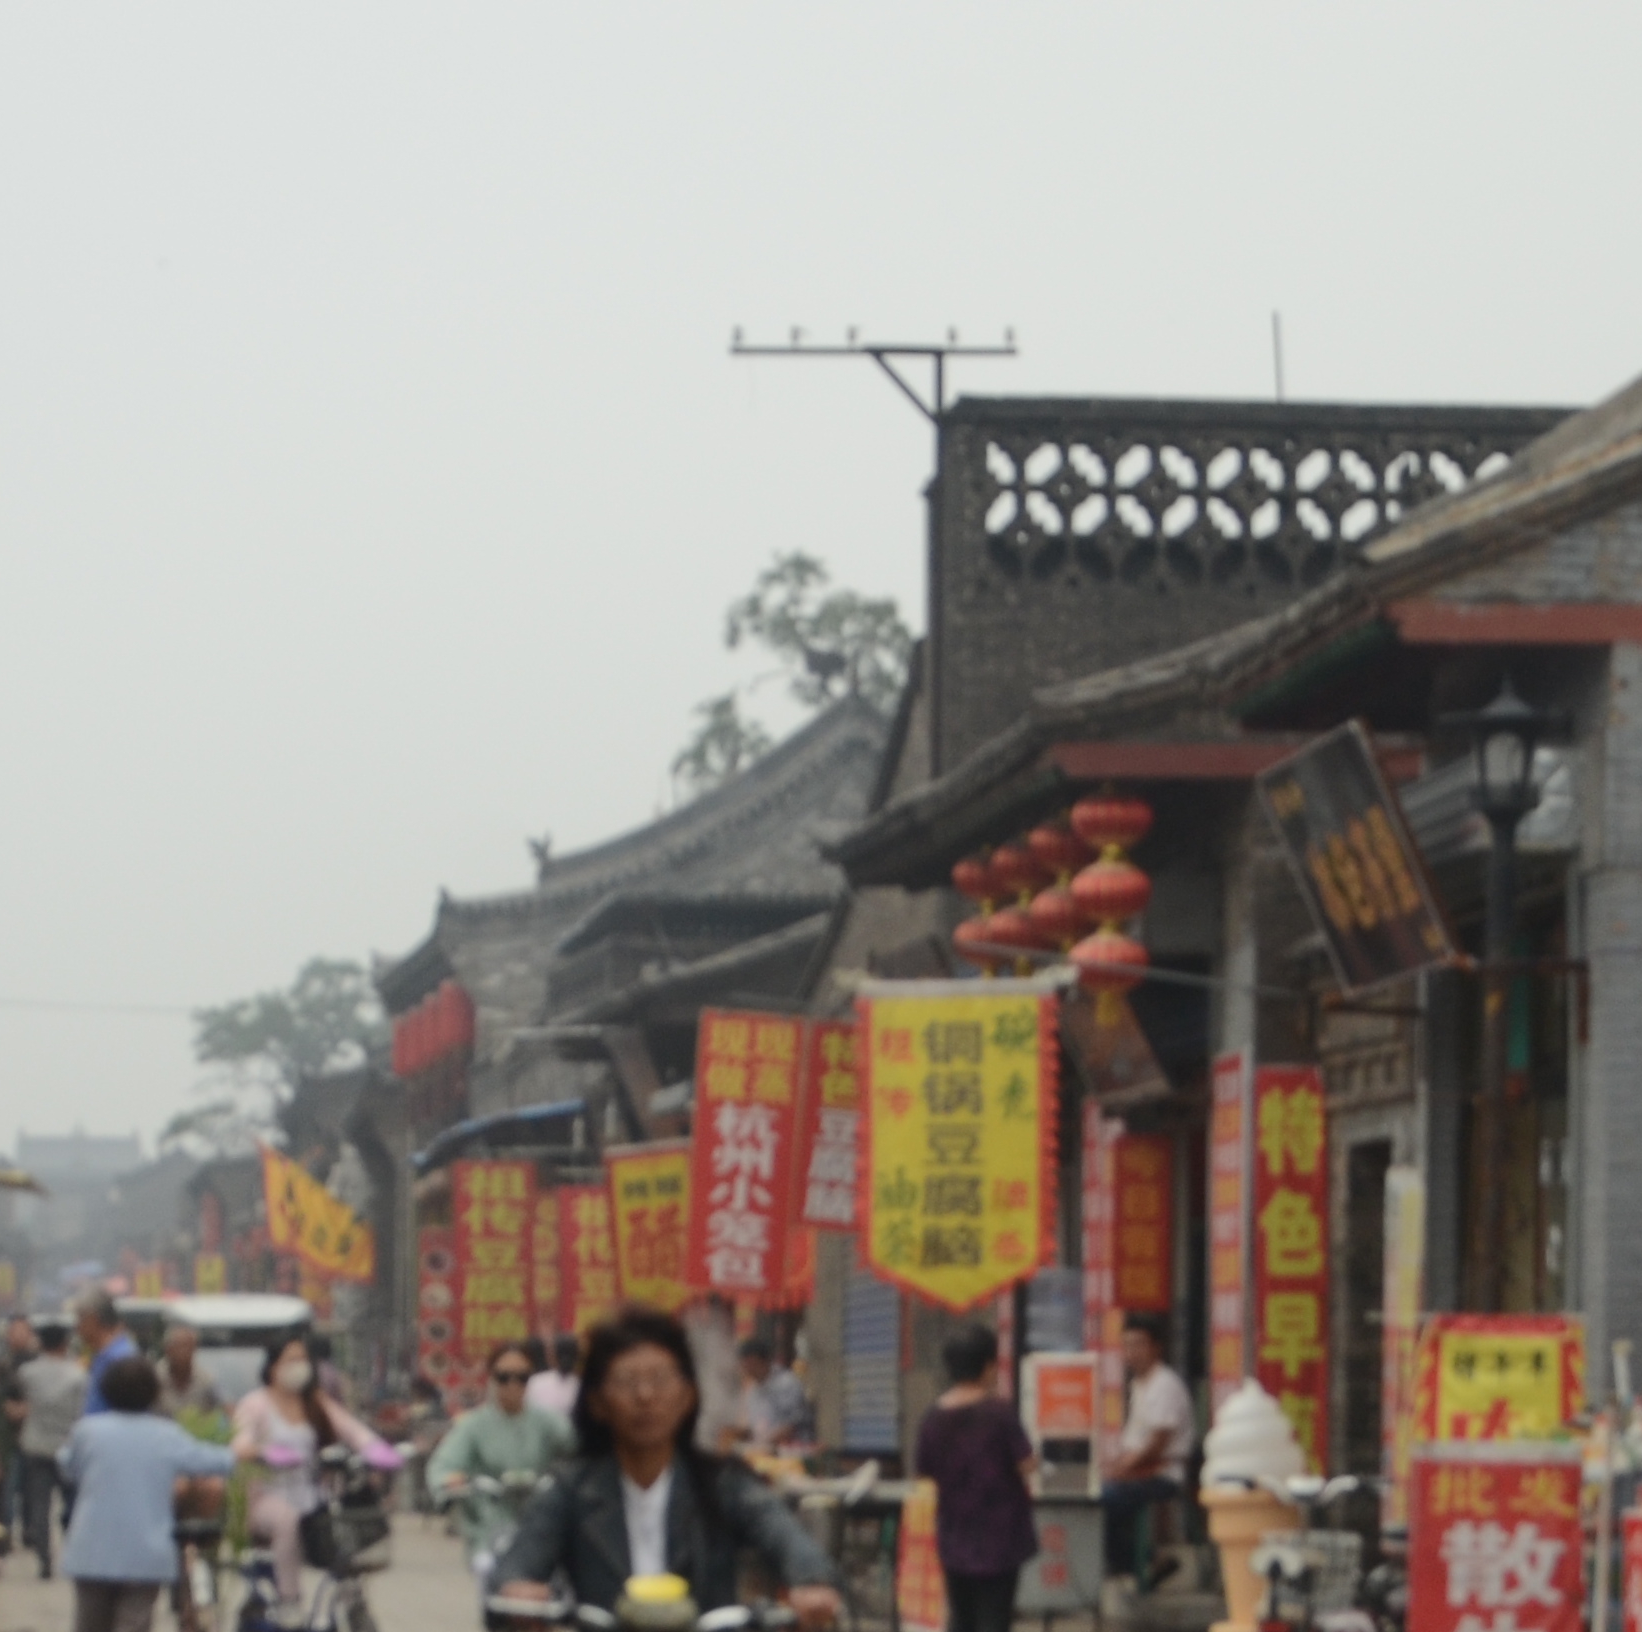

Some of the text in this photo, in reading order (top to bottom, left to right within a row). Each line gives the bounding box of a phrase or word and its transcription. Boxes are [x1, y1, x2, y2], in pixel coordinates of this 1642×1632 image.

[703, 1101, 781, 1290] 杭州小笼包
